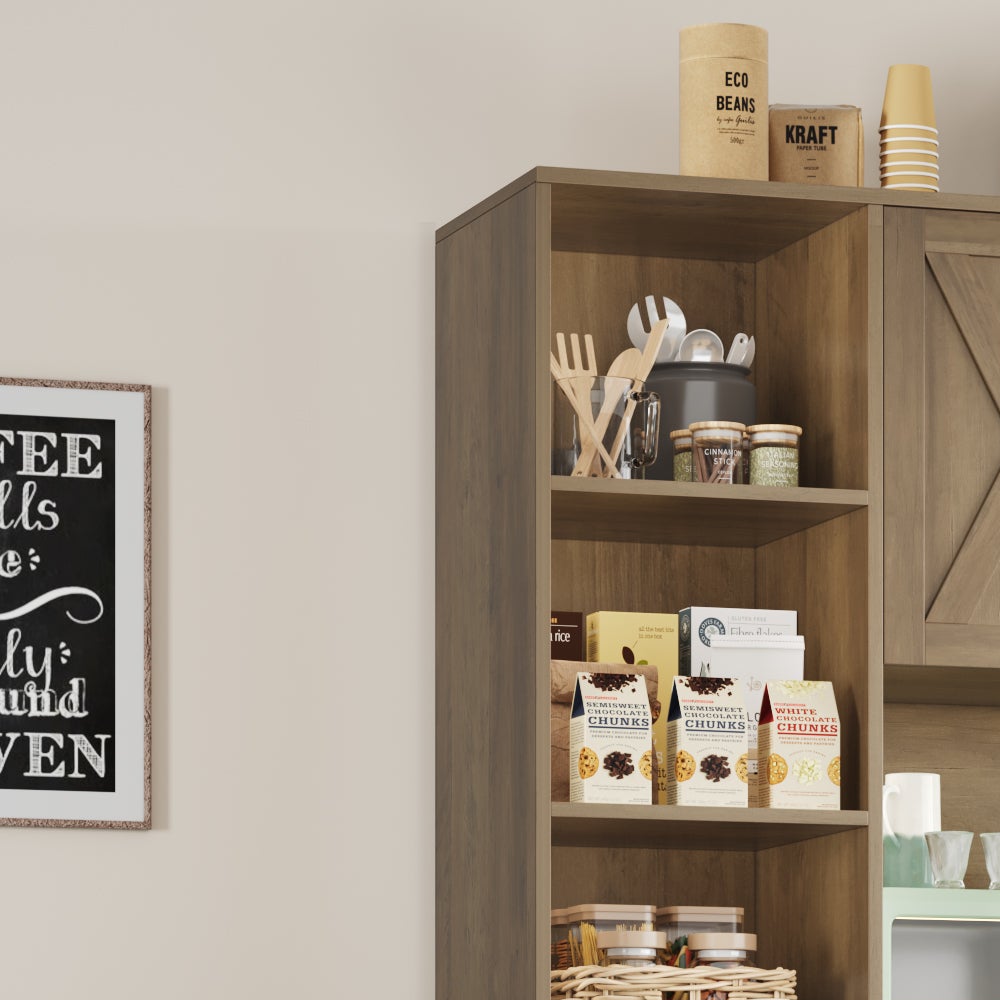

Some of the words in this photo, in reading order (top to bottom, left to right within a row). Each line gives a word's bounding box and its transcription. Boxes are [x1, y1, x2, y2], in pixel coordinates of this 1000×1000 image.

[725, 71, 749, 88] ECO
[716, 95, 756, 113] BEANS
[785, 124, 838, 145] KRAFT
[704, 448, 742, 457] CINNAMON
[713, 457, 736, 466] STICK
[554, 629, 571, 643] rice
[586, 701, 647, 710] SEMISWEET
[683, 705, 743, 713] SEMISWEET
[587, 708, 649, 717] CHOCOLATE
[684, 712, 745, 720] CHOCOLATE
[775, 707, 817, 716] WHITE
[588, 716, 649, 727] CHUNKS
[776, 715, 837, 723] CHOCOLATE
[685, 719, 746, 730] CHUNKS
[777, 723, 838, 733] CHUNKS
